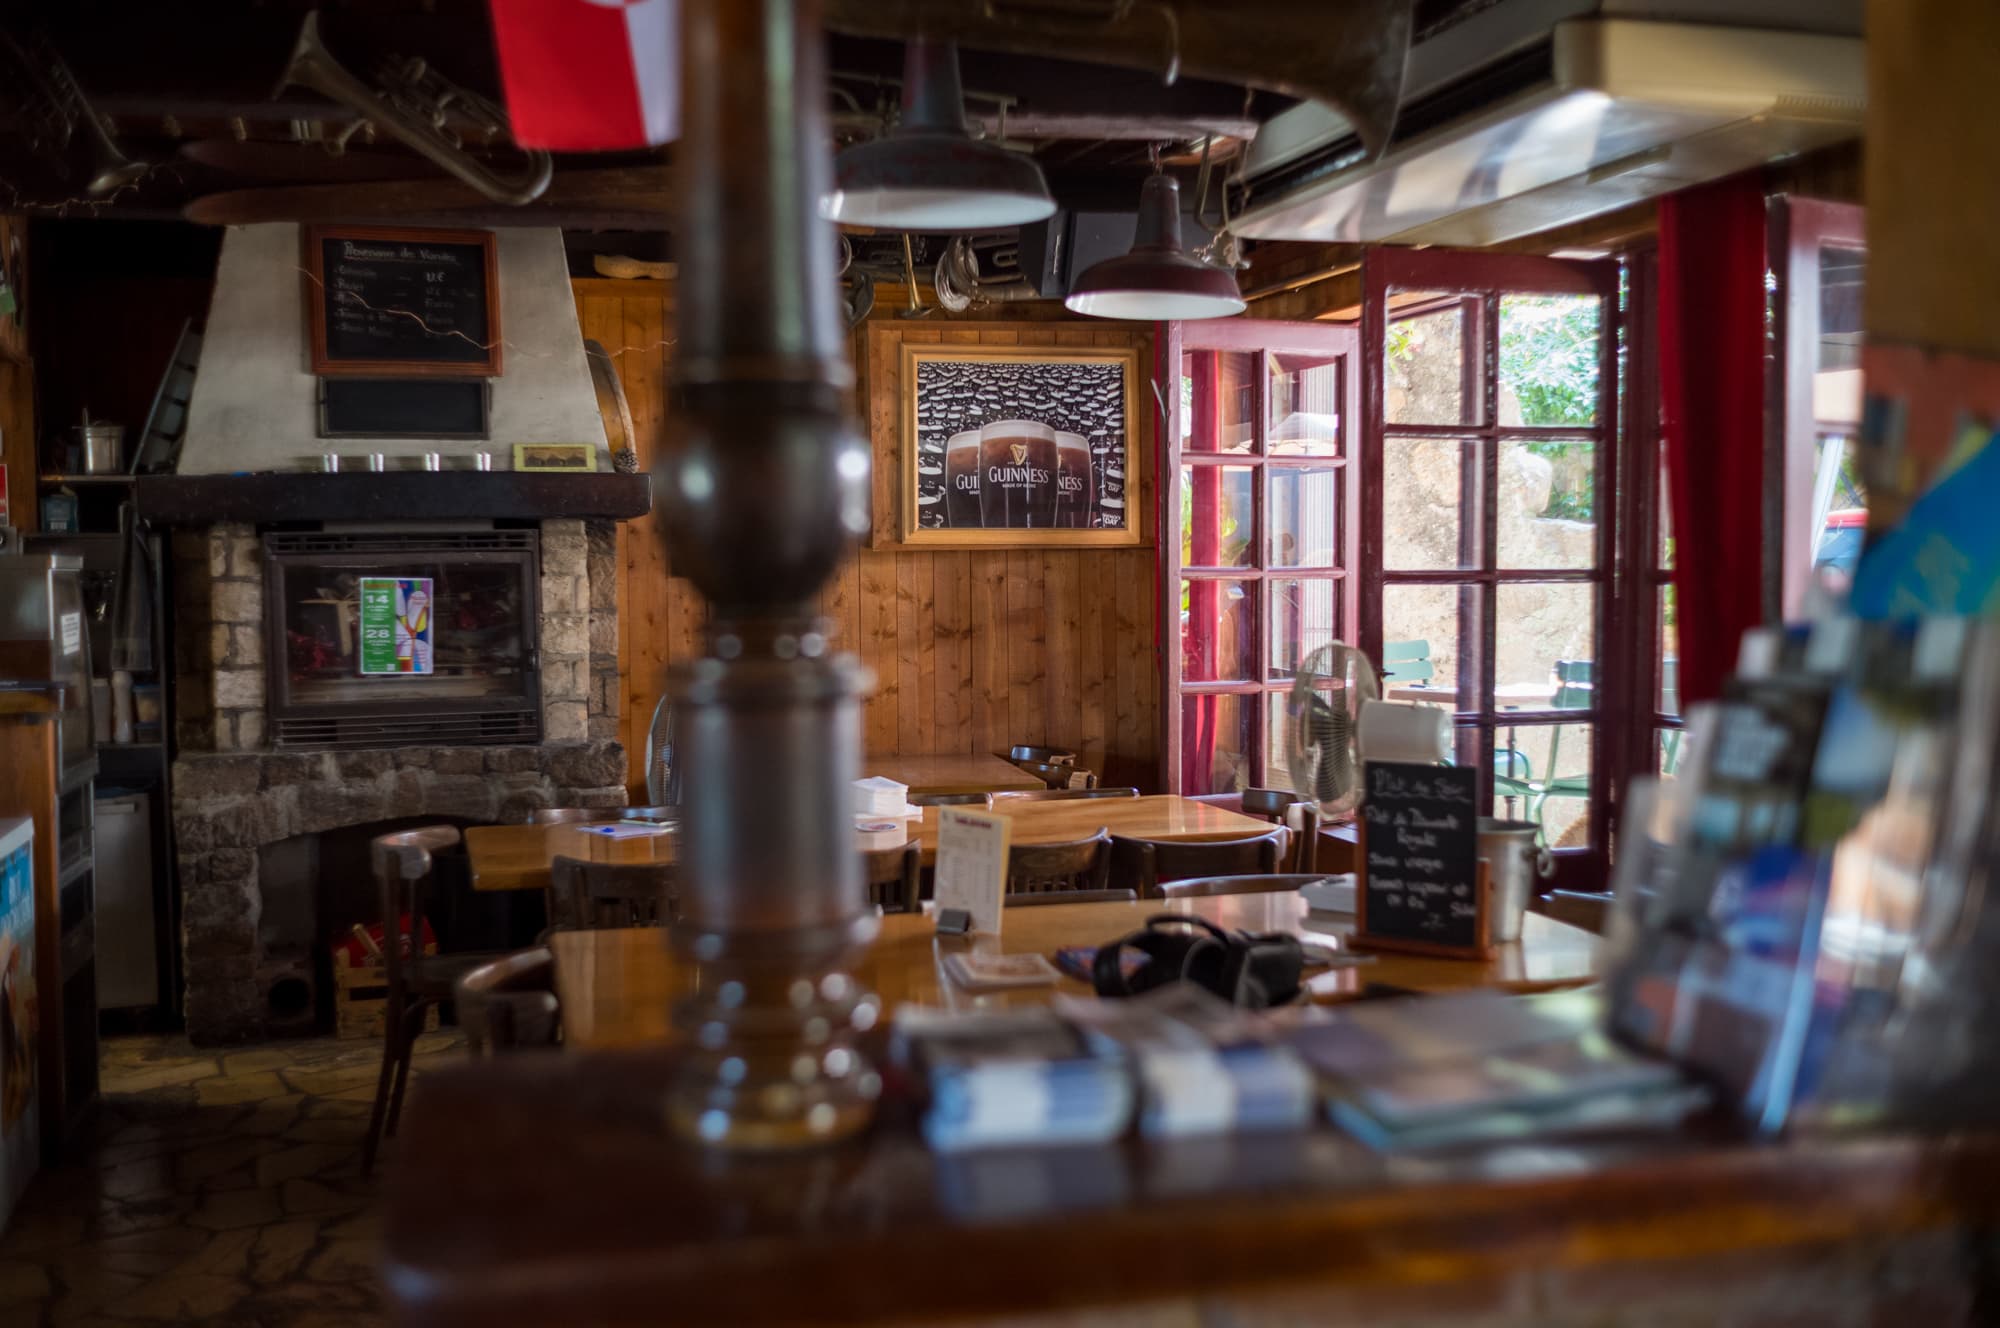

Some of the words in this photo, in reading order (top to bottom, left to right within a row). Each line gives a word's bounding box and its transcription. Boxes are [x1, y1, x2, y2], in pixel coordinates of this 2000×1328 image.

[988, 466, 1049, 483] GUINNESS
[366, 594, 389, 604] 14
[366, 629, 390, 639] 28
